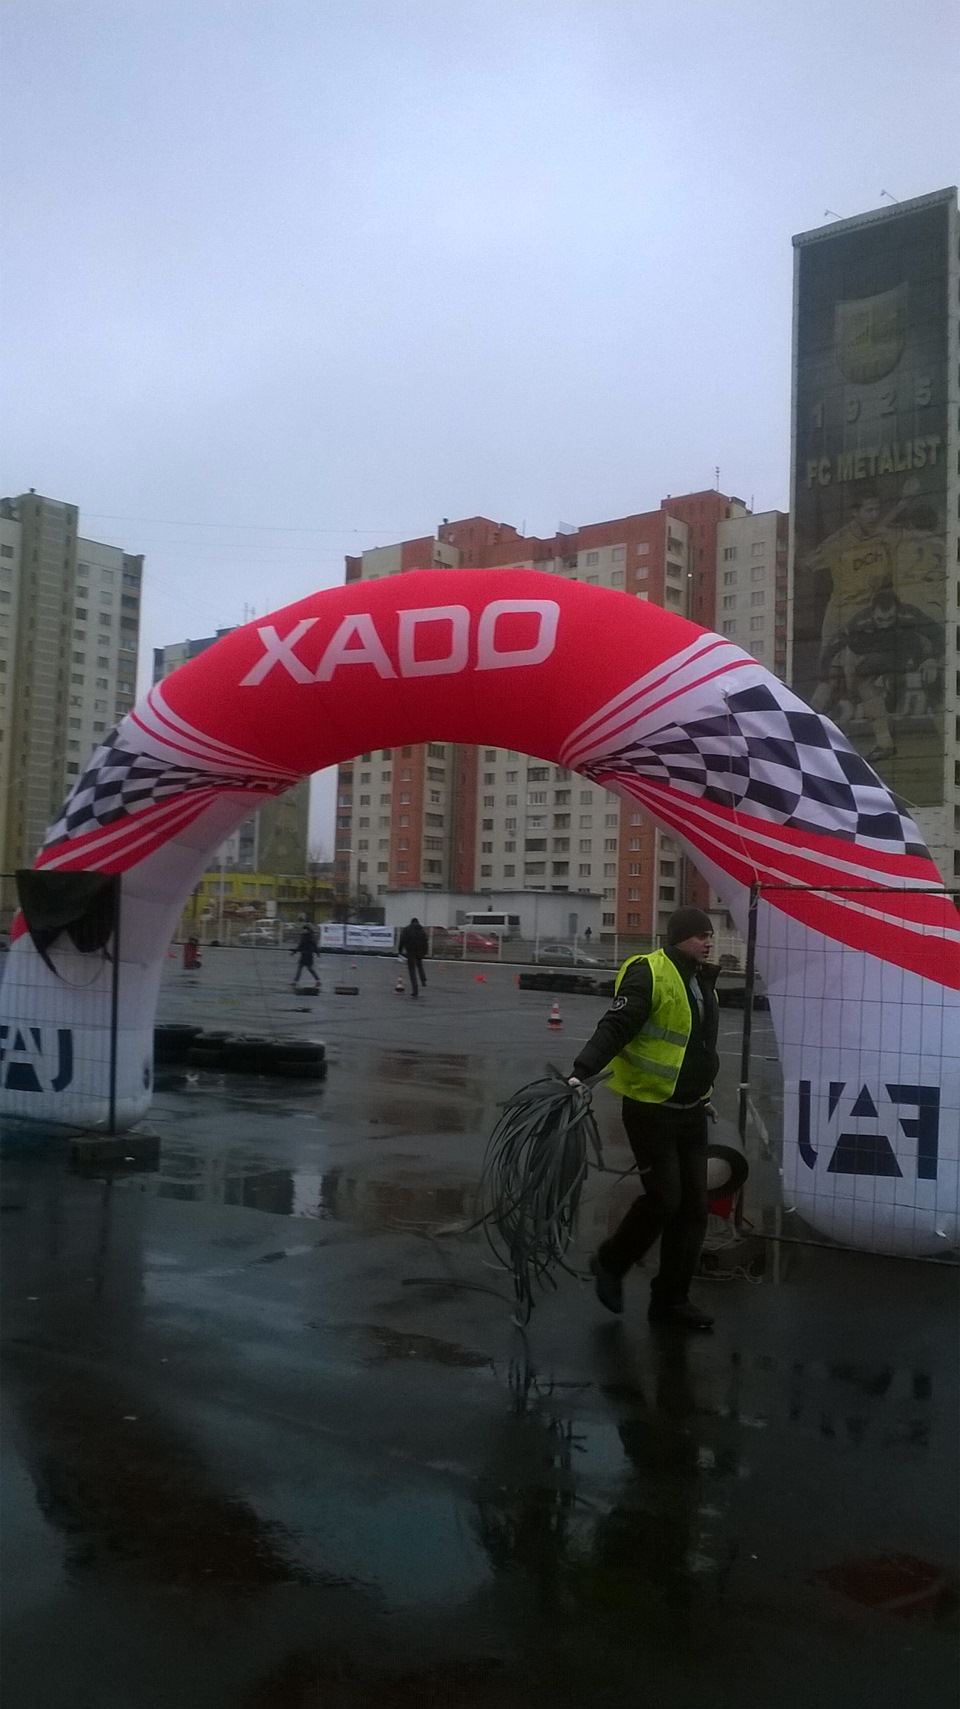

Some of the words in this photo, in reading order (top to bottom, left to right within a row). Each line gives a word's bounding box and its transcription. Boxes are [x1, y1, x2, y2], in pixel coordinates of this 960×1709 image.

[807, 457, 832, 488] FC
[838, 435, 941, 482] METALIST
[238, 599, 561, 686] XADO
